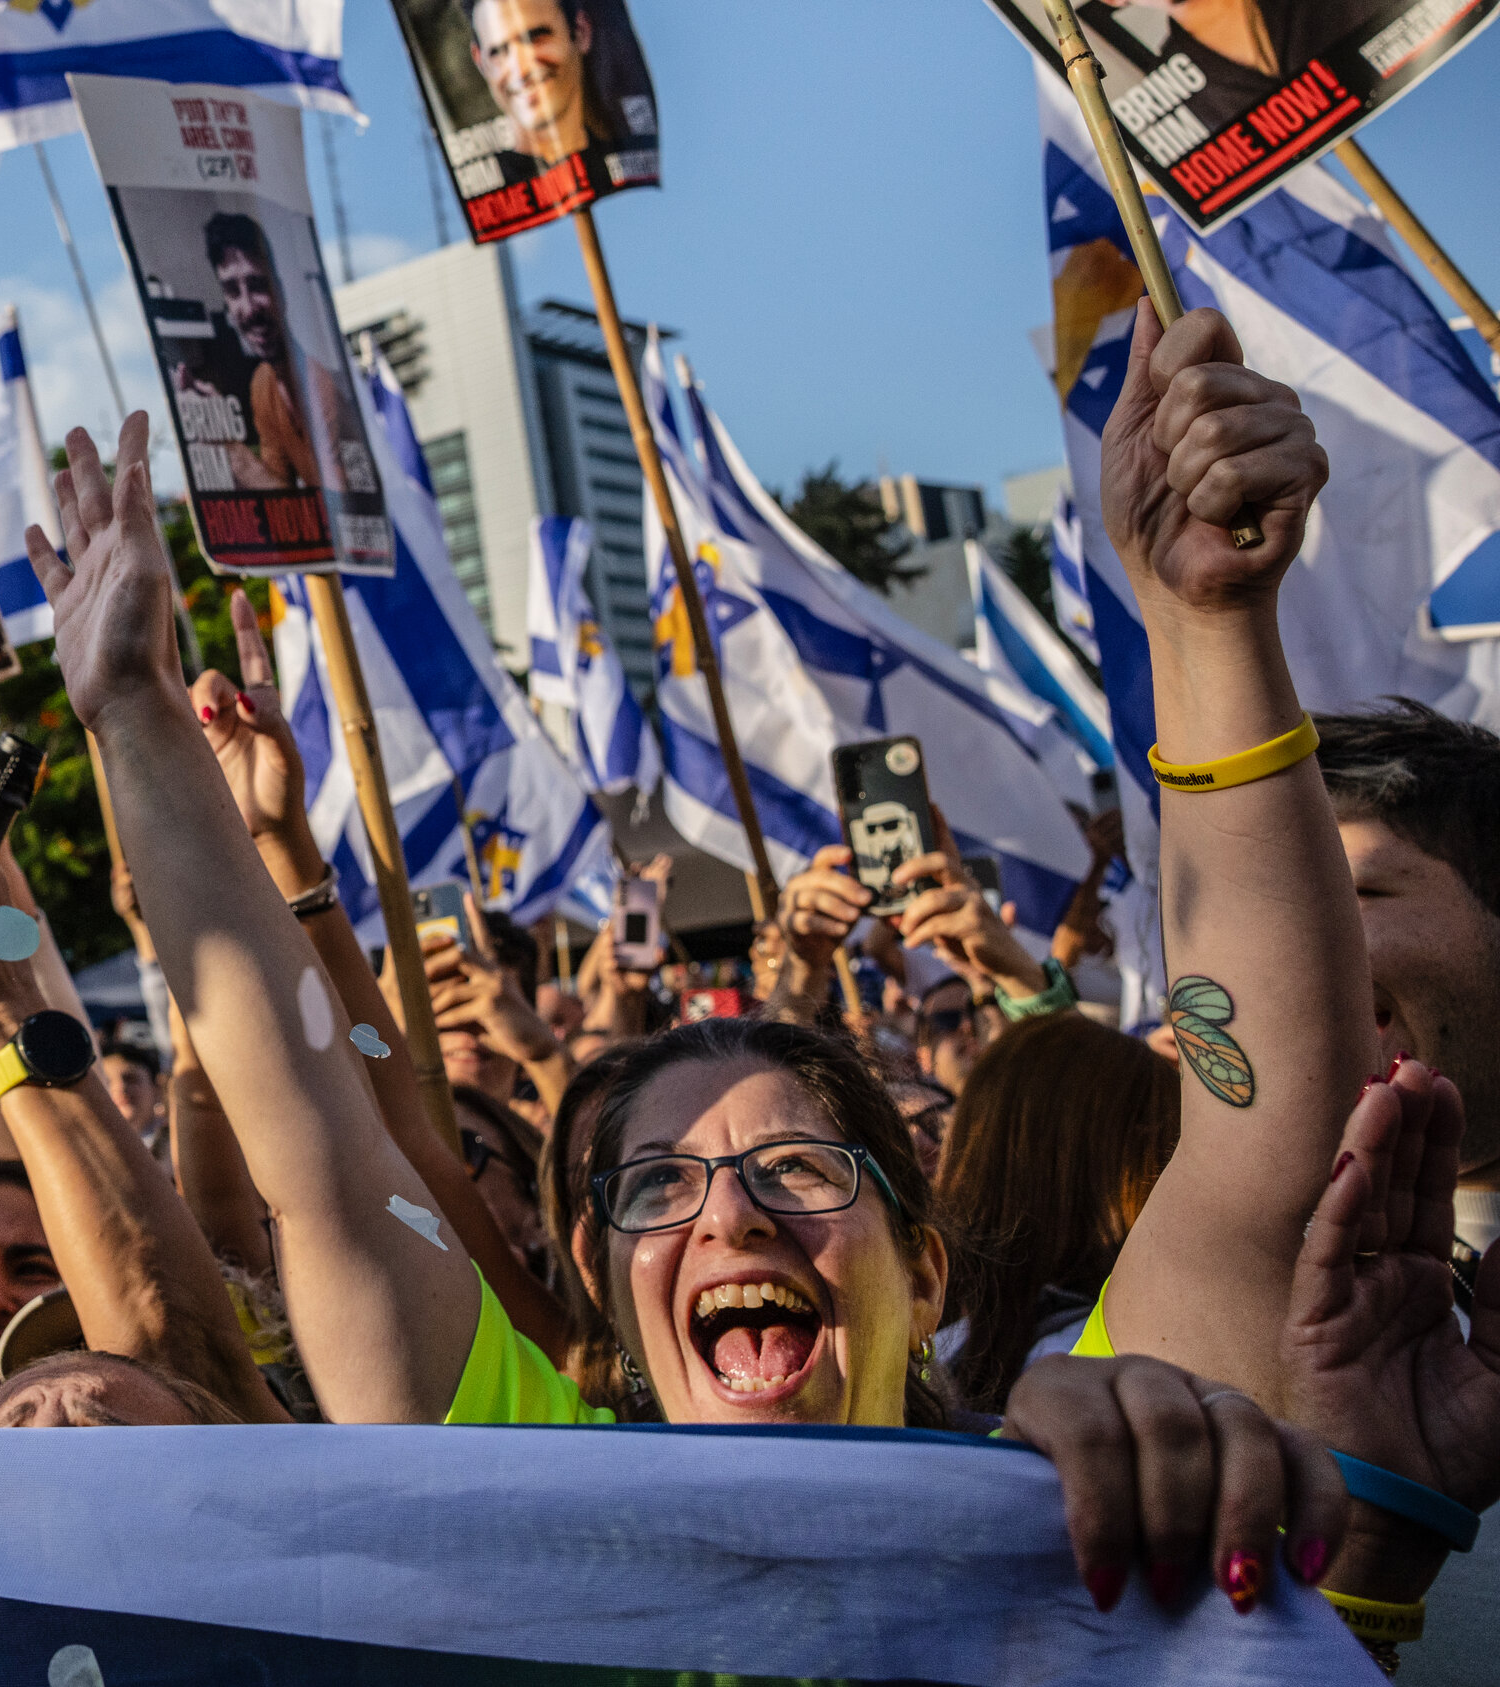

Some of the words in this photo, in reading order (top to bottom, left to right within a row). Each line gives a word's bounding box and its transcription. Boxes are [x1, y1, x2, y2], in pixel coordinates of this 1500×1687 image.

[1110, 53, 1207, 133] BRING
[1139, 104, 1210, 169] HIM
[1170, 123, 1265, 200] HOME
[1247, 59, 1347, 147] NOW!
[467, 182, 535, 232] HOME
[176, 390, 248, 442] BRING
[187, 442, 237, 492] HIM
[201, 499, 266, 546] HOME
